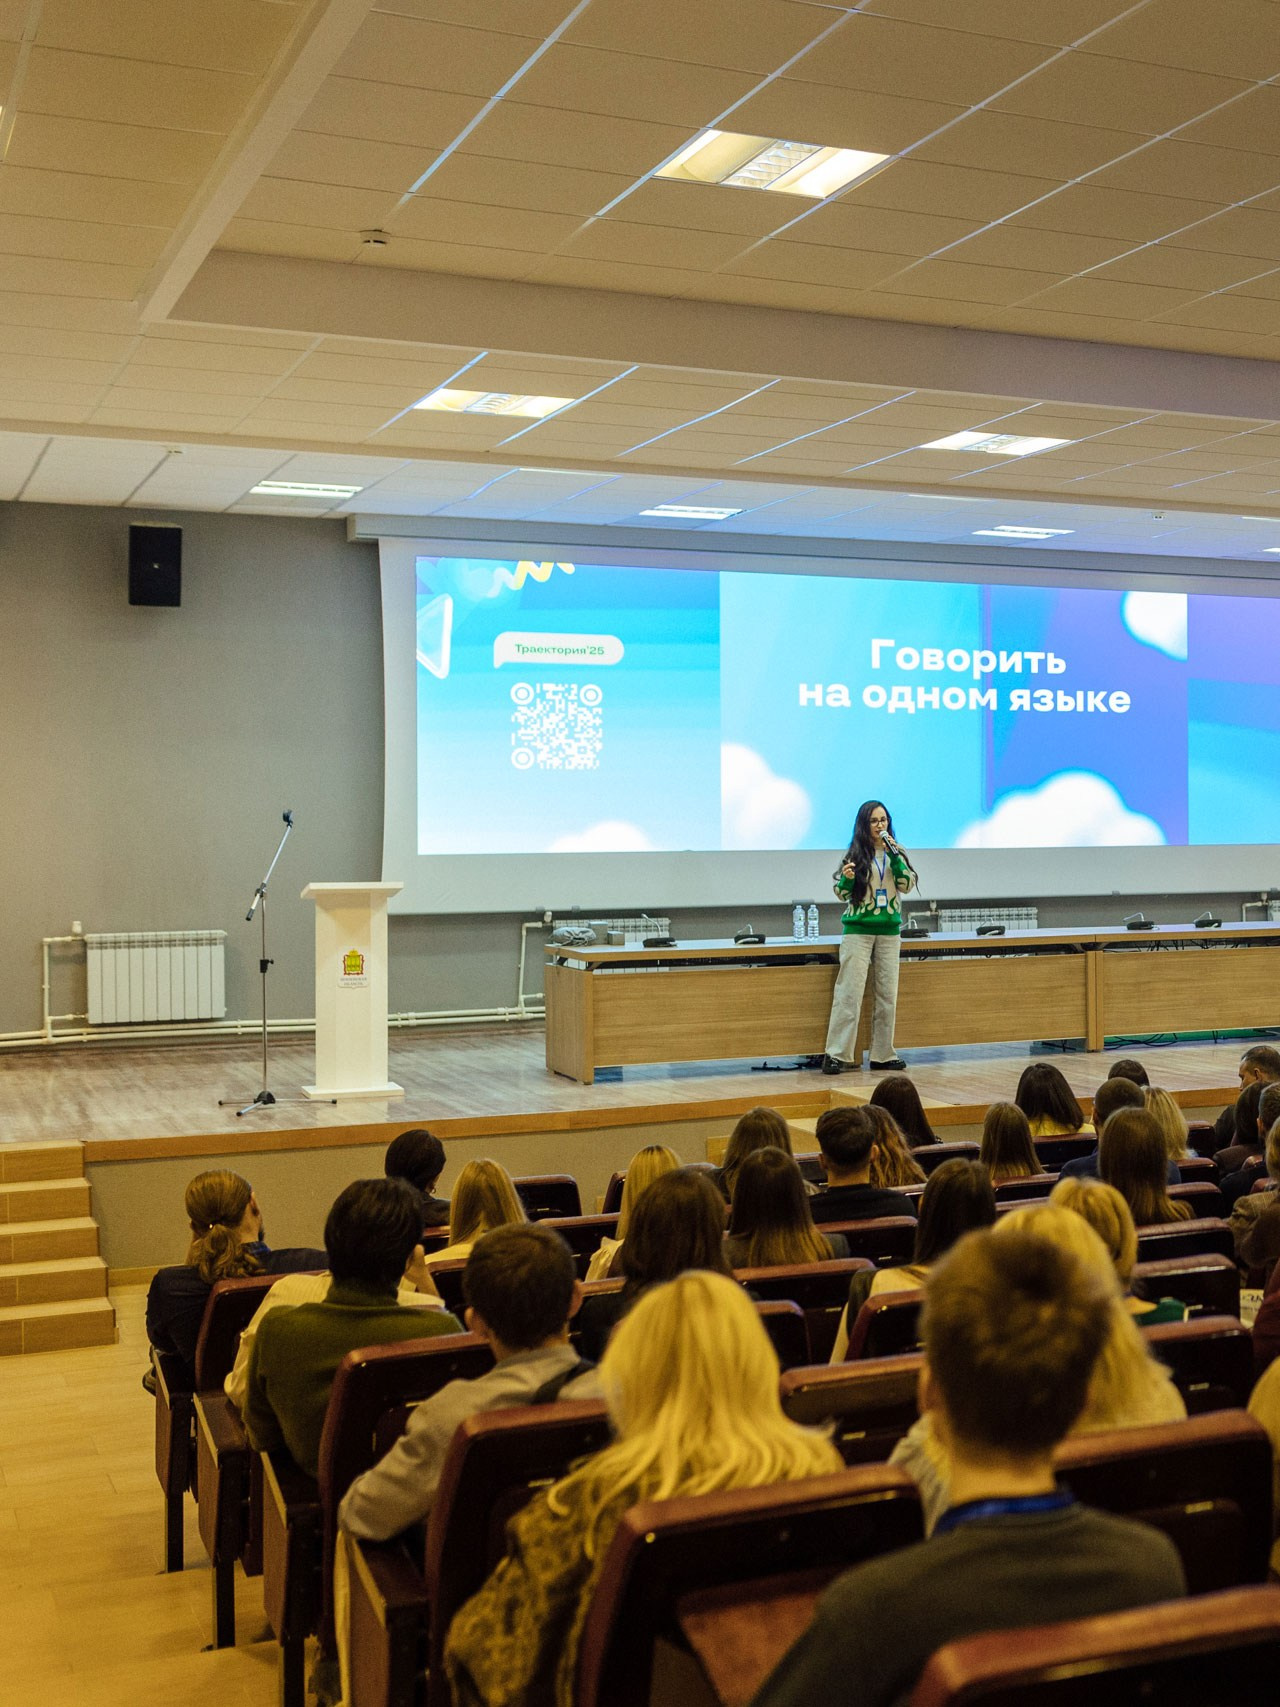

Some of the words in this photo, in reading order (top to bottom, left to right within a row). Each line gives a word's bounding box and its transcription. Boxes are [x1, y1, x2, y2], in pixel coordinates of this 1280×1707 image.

[515, 643, 604, 656] Траектория'25
[870, 638, 1066, 680] Говорить
[799, 683, 851, 708] на
[862, 685, 997, 715] одном
[1009, 688, 1131, 714] языке
